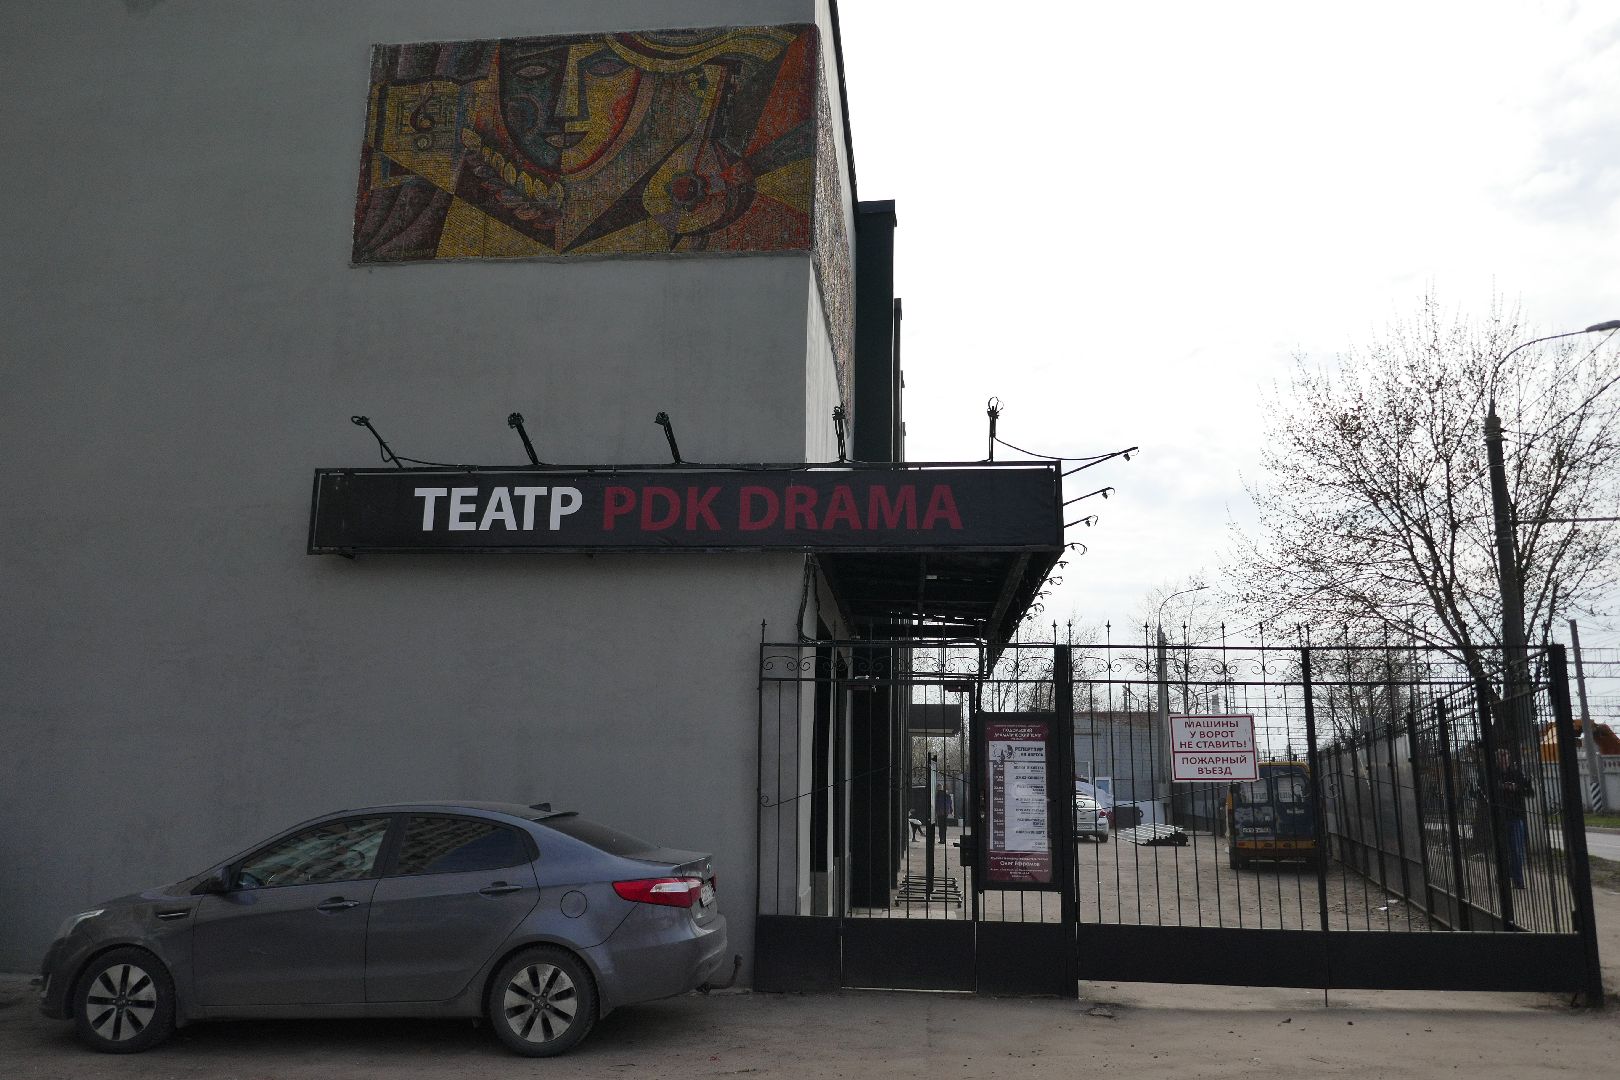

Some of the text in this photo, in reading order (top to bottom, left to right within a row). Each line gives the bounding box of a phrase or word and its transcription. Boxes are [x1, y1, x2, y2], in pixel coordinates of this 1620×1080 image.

[414, 485, 964, 531] ТЕАТР PDK DRAMA
[1184, 720, 1239, 728] МАШИНЫ
[1199, 730, 1235, 738] ВОРОТ
[1179, 740, 1247, 749] НЕ СТАВИТЬ!
[1181, 755, 1247, 765] ПОЖАРНЫЙ
[1197, 767, 1233, 775] ВЪЕЗД
